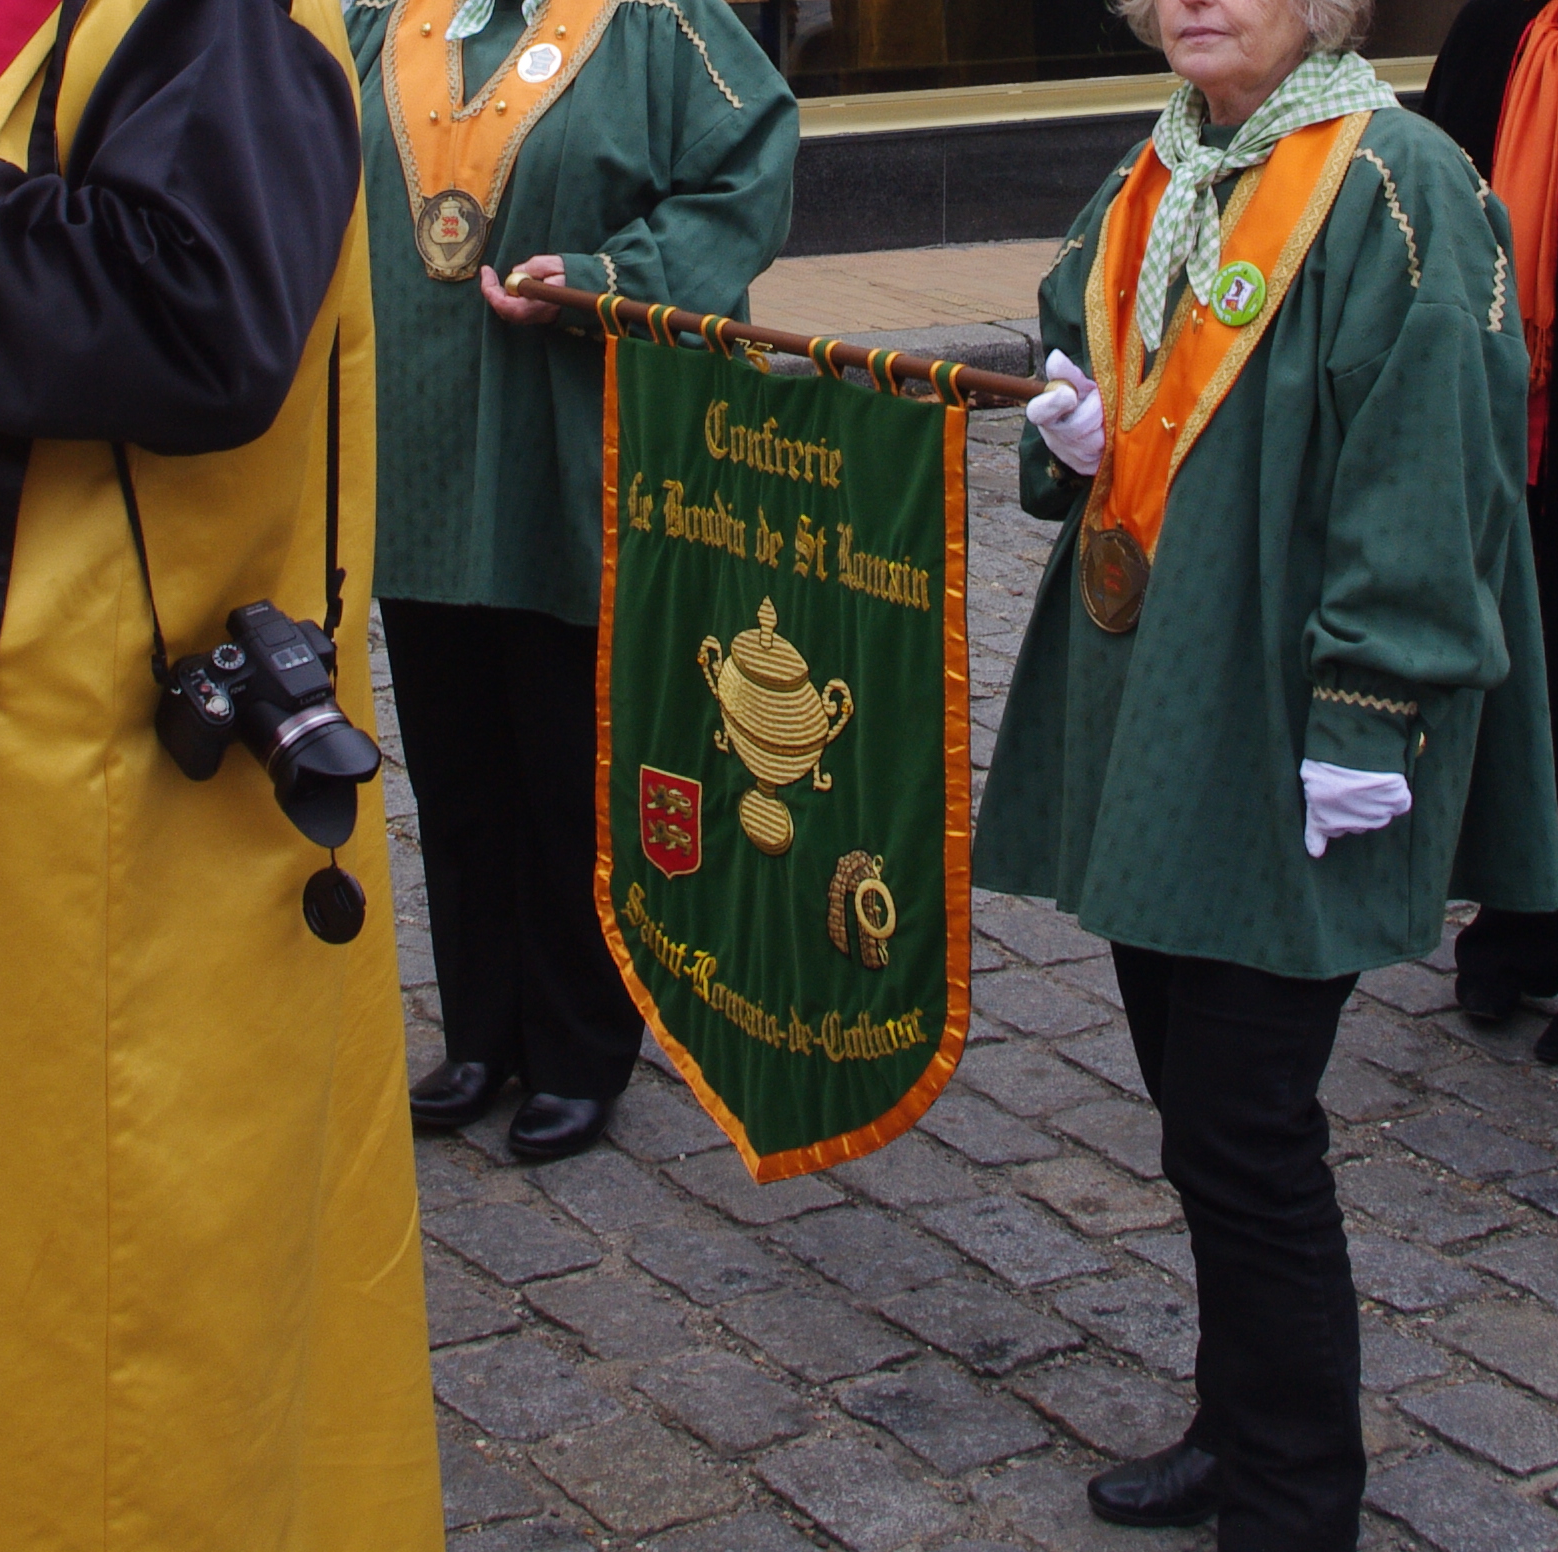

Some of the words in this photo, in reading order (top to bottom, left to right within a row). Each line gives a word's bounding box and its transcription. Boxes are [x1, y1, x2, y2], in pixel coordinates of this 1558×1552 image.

[704, 399, 844, 490] Confrerie
[661, 479, 747, 560] Boudin
[754, 505, 785, 570] de
[793, 513, 829, 582] St
[836, 522, 931, 612] Romain
